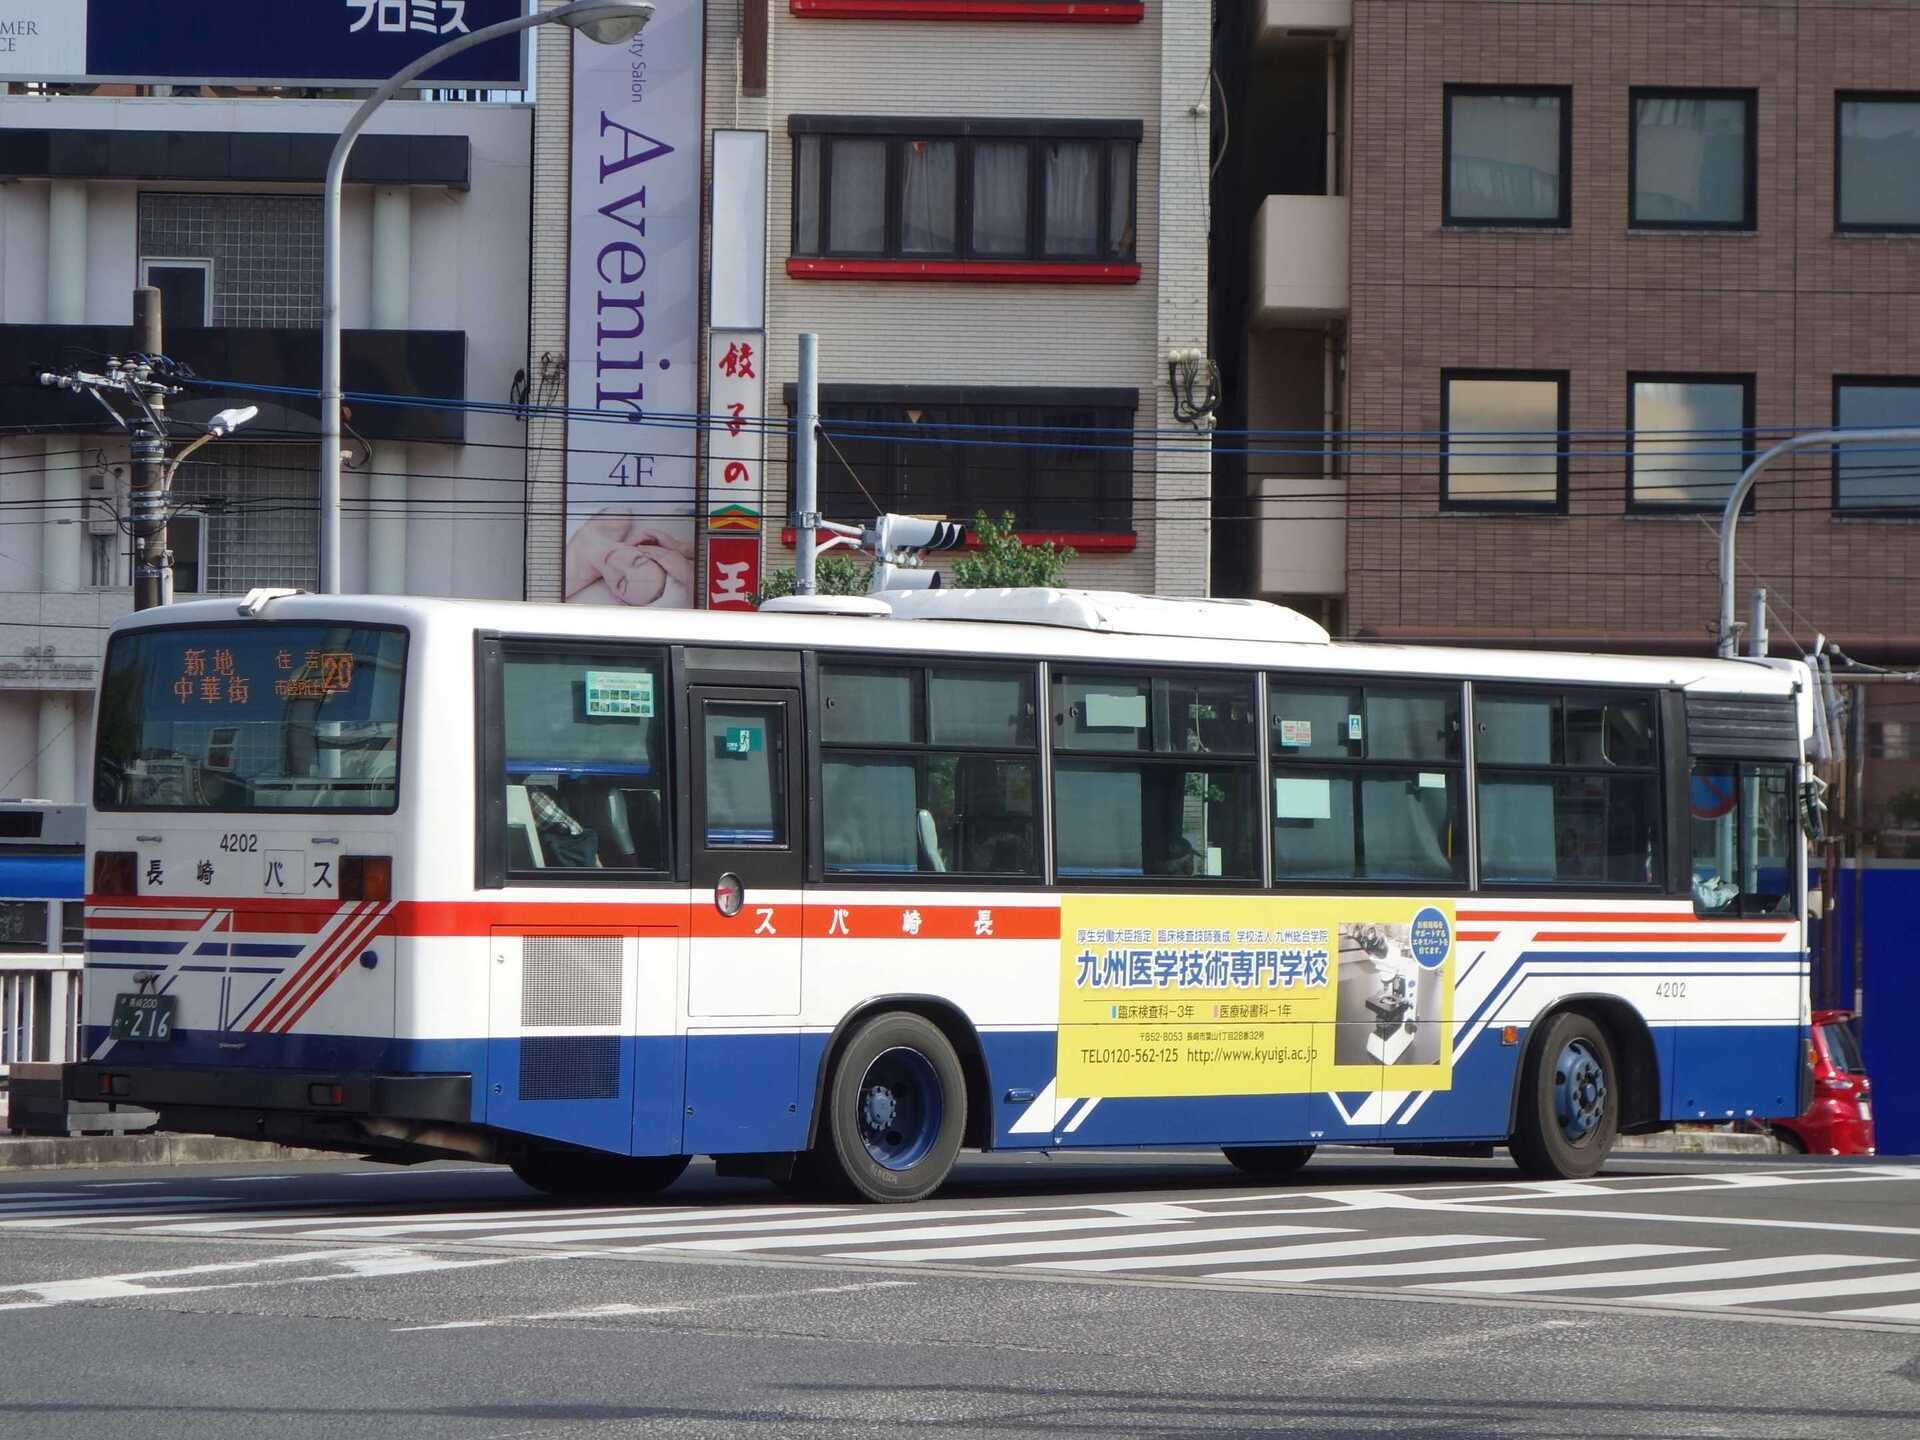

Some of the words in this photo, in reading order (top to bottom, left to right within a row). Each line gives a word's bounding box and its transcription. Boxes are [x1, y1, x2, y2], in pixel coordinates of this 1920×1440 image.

[631, 61, 646, 103] Salon
[596, 110, 675, 422] Avenir
[718, 342, 756, 484] 餃子の
[608, 453, 655, 487] 4F
[711, 561, 750, 603] 王
[220, 833, 258, 853] 4202
[1077, 950, 1328, 986] 九州医学技術専門学校
[1656, 982, 1686, 997] 4202
